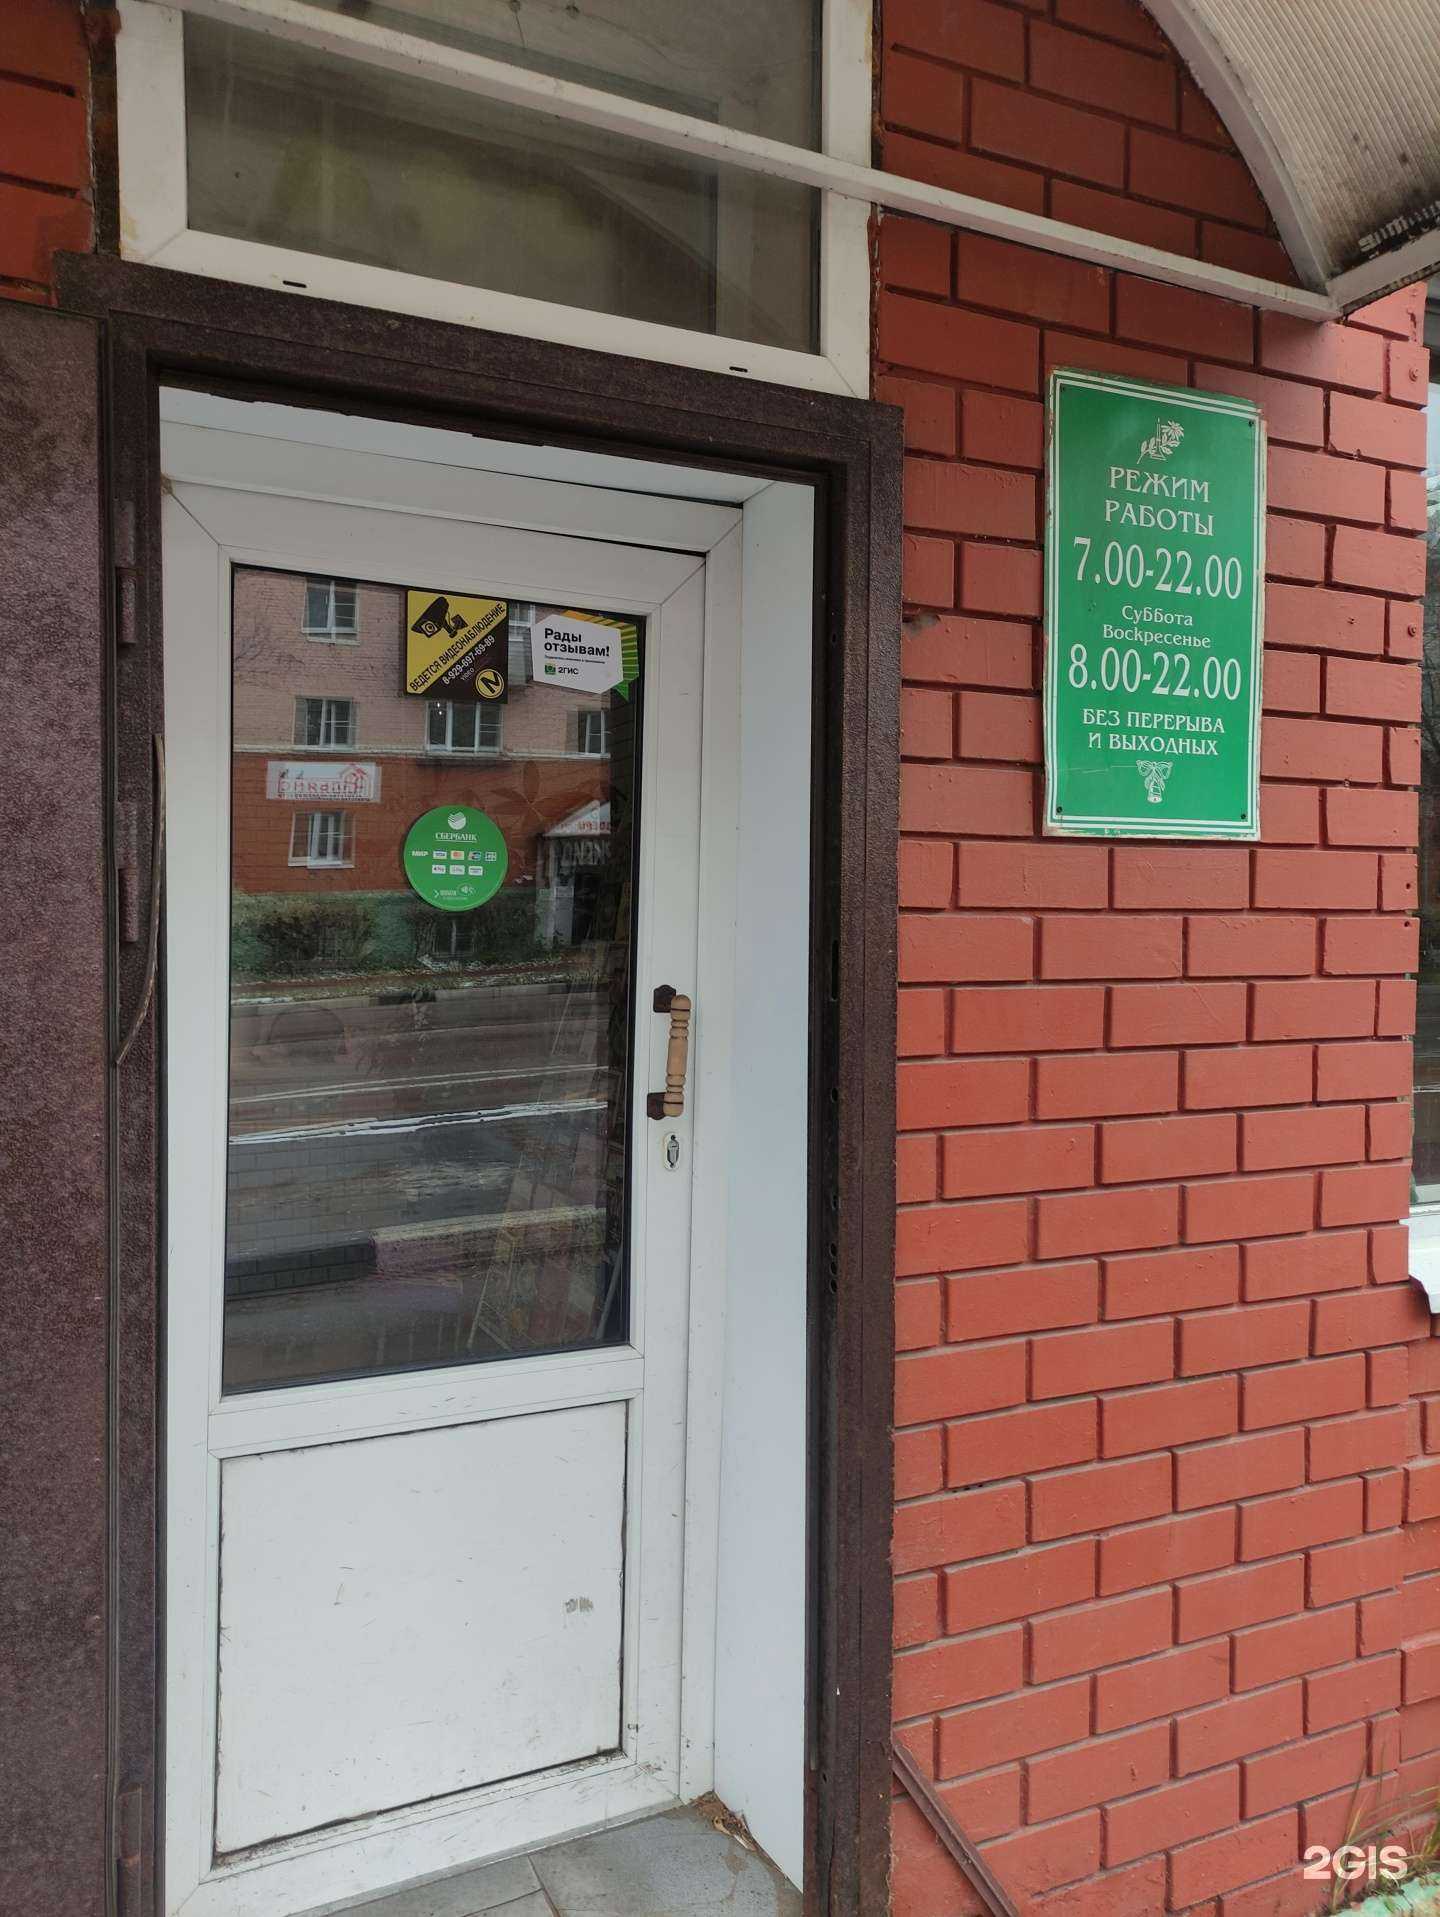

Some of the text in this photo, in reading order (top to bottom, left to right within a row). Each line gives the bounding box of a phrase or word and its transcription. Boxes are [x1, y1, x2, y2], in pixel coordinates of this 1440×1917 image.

[1109, 466, 1209, 502] РЕЖИМ
[1104, 500, 1215, 536] РАБОТЫ
[1073, 536, 1242, 599] 7.00-22.00
[1122, 605, 1193, 626] Суббота
[409, 602, 506, 691] ВЕДЕТСЯ ВИДЕОНАБЛЮДЕНИЕ
[544, 628, 582, 643] Рады
[1103, 624, 1211, 648] Воскресенье
[544, 642, 610, 657] отзывам!
[558, 666, 579, 675] 2ГИС
[1068, 643, 1242, 700] 8.00-22.00
[1083, 708, 1225, 733] БЕЗ ПЕРЕРЫВА
[1088, 732, 1218, 755] И ВЫХОДНЫХ
